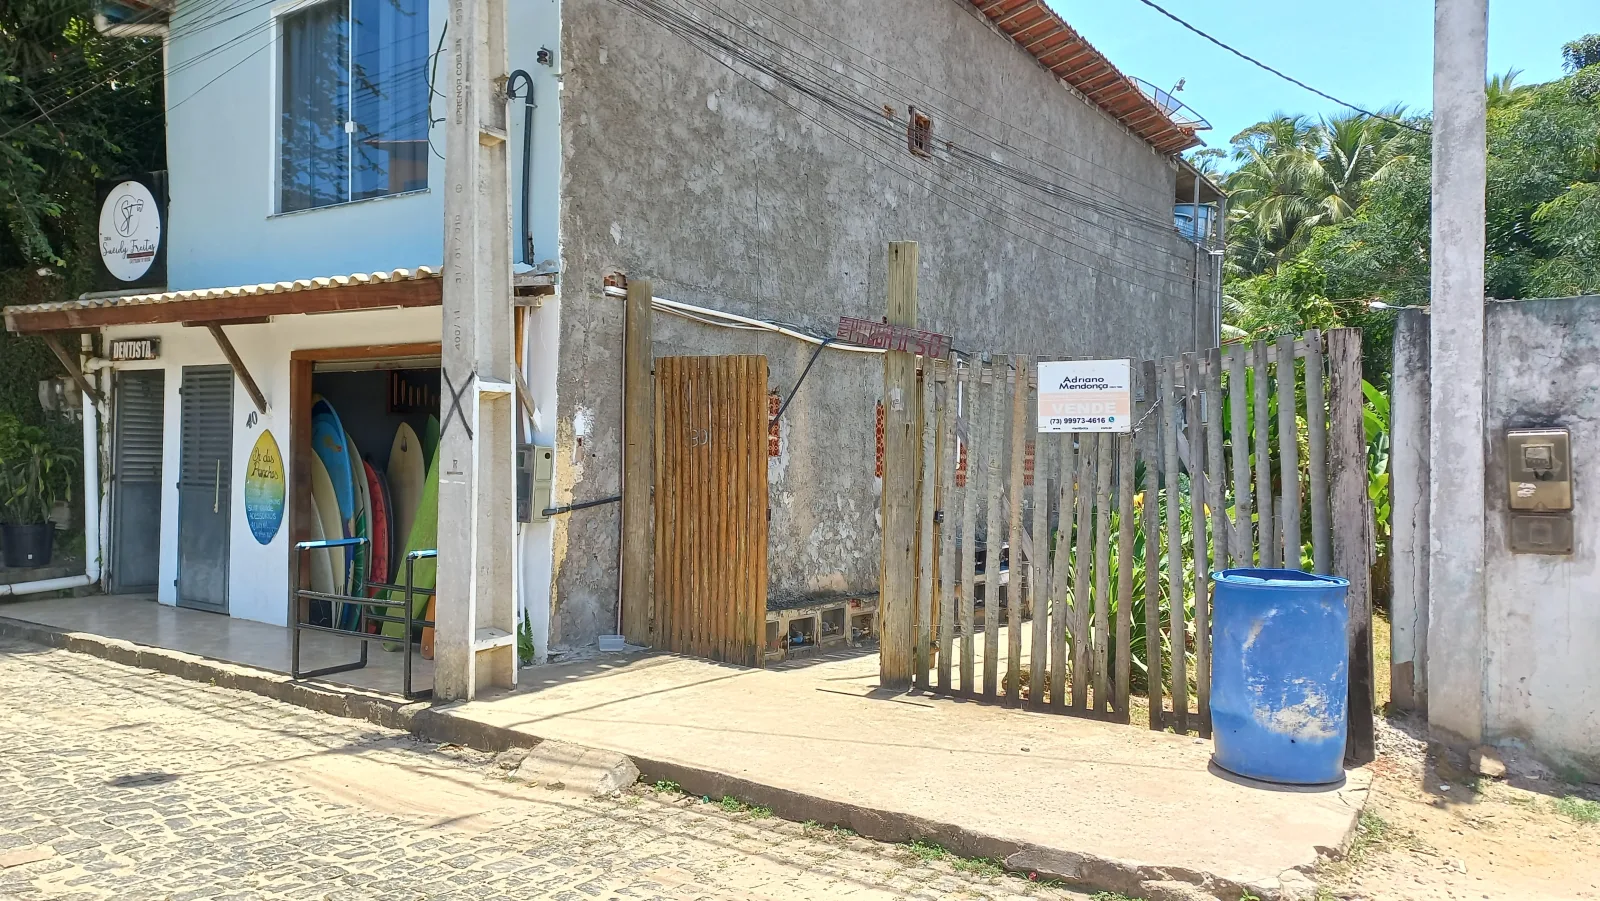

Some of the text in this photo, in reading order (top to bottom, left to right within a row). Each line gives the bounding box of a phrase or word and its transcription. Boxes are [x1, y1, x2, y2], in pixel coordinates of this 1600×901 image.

[113, 340, 151, 359] DENTISTA
[1063, 376, 1105, 384] Adriano
[1059, 383, 1109, 391] Mendonça
[1051, 402, 1117, 414] VENDE
[246, 410, 258, 429] 40
